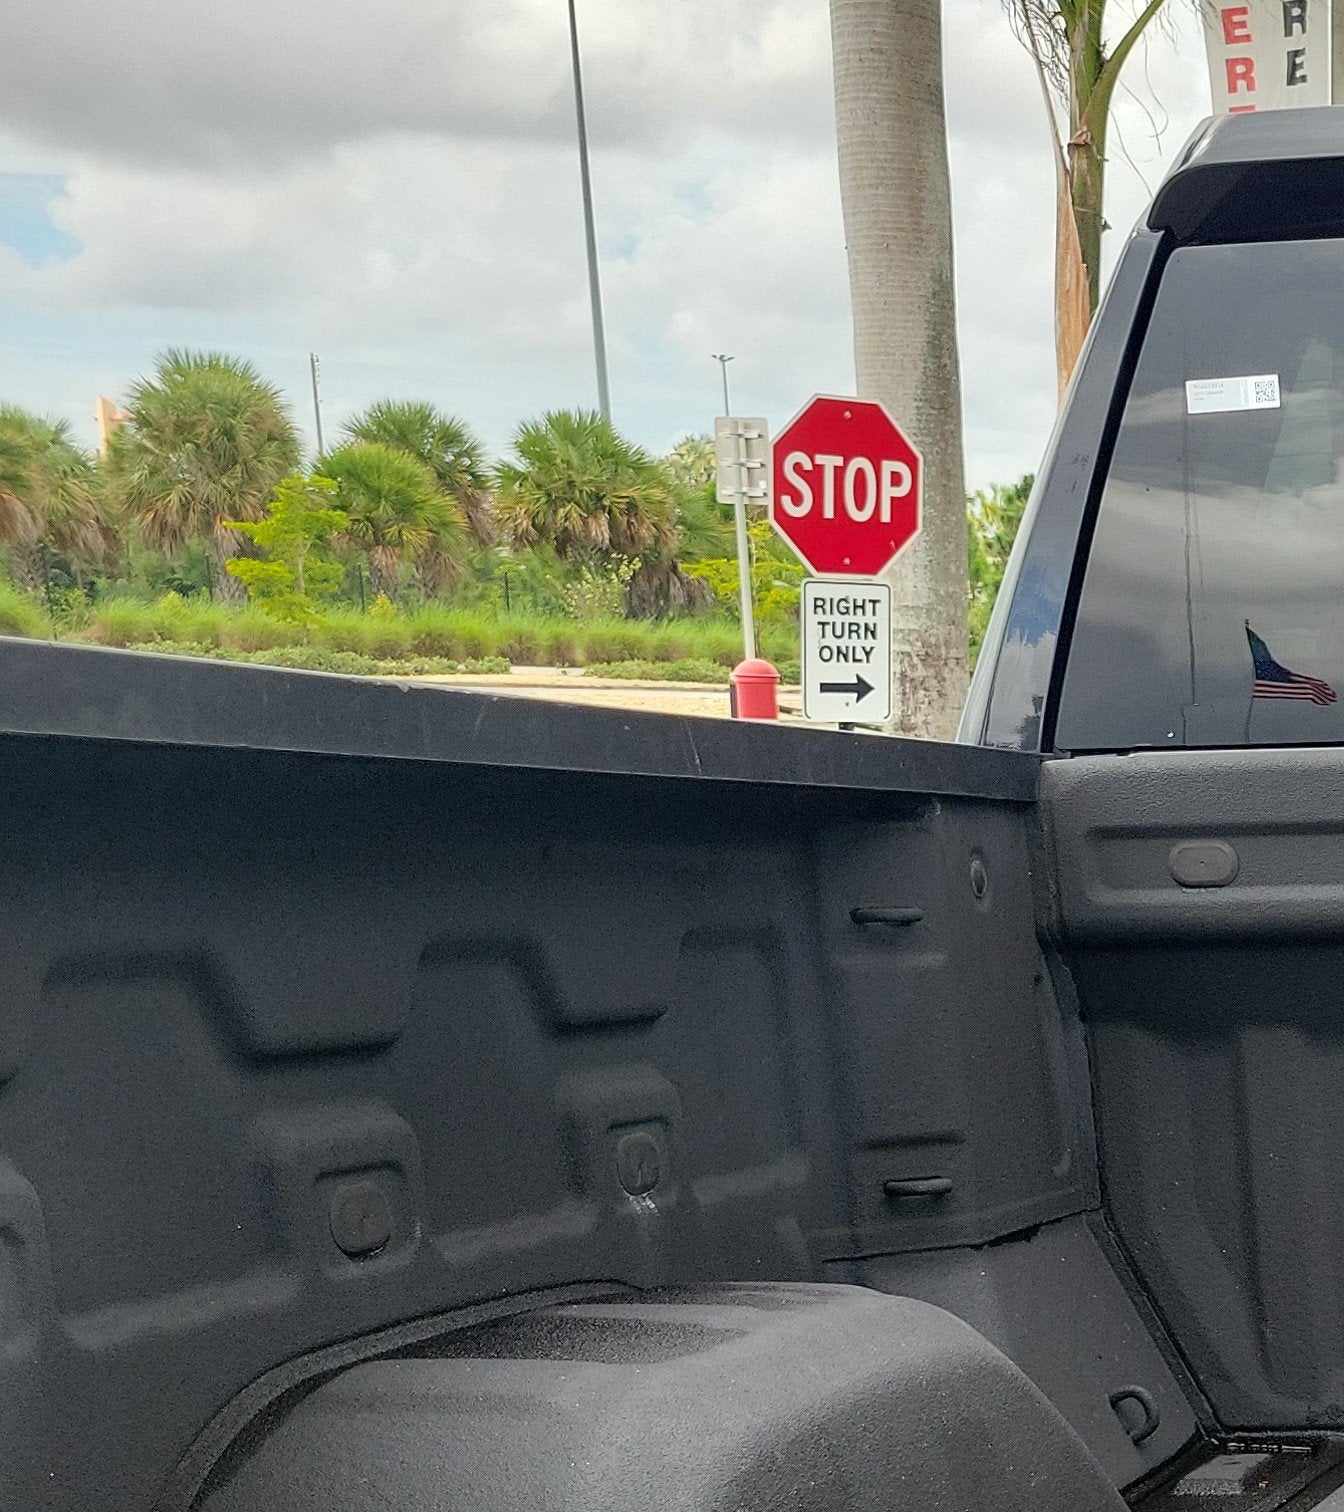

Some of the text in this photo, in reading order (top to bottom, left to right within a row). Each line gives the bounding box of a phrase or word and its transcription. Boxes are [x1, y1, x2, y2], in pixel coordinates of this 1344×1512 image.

[780, 451, 913, 523] STOP
[813, 596, 882, 616] RIGHT
[816, 621, 878, 640] TURN
[818, 645, 876, 664] ONLY
